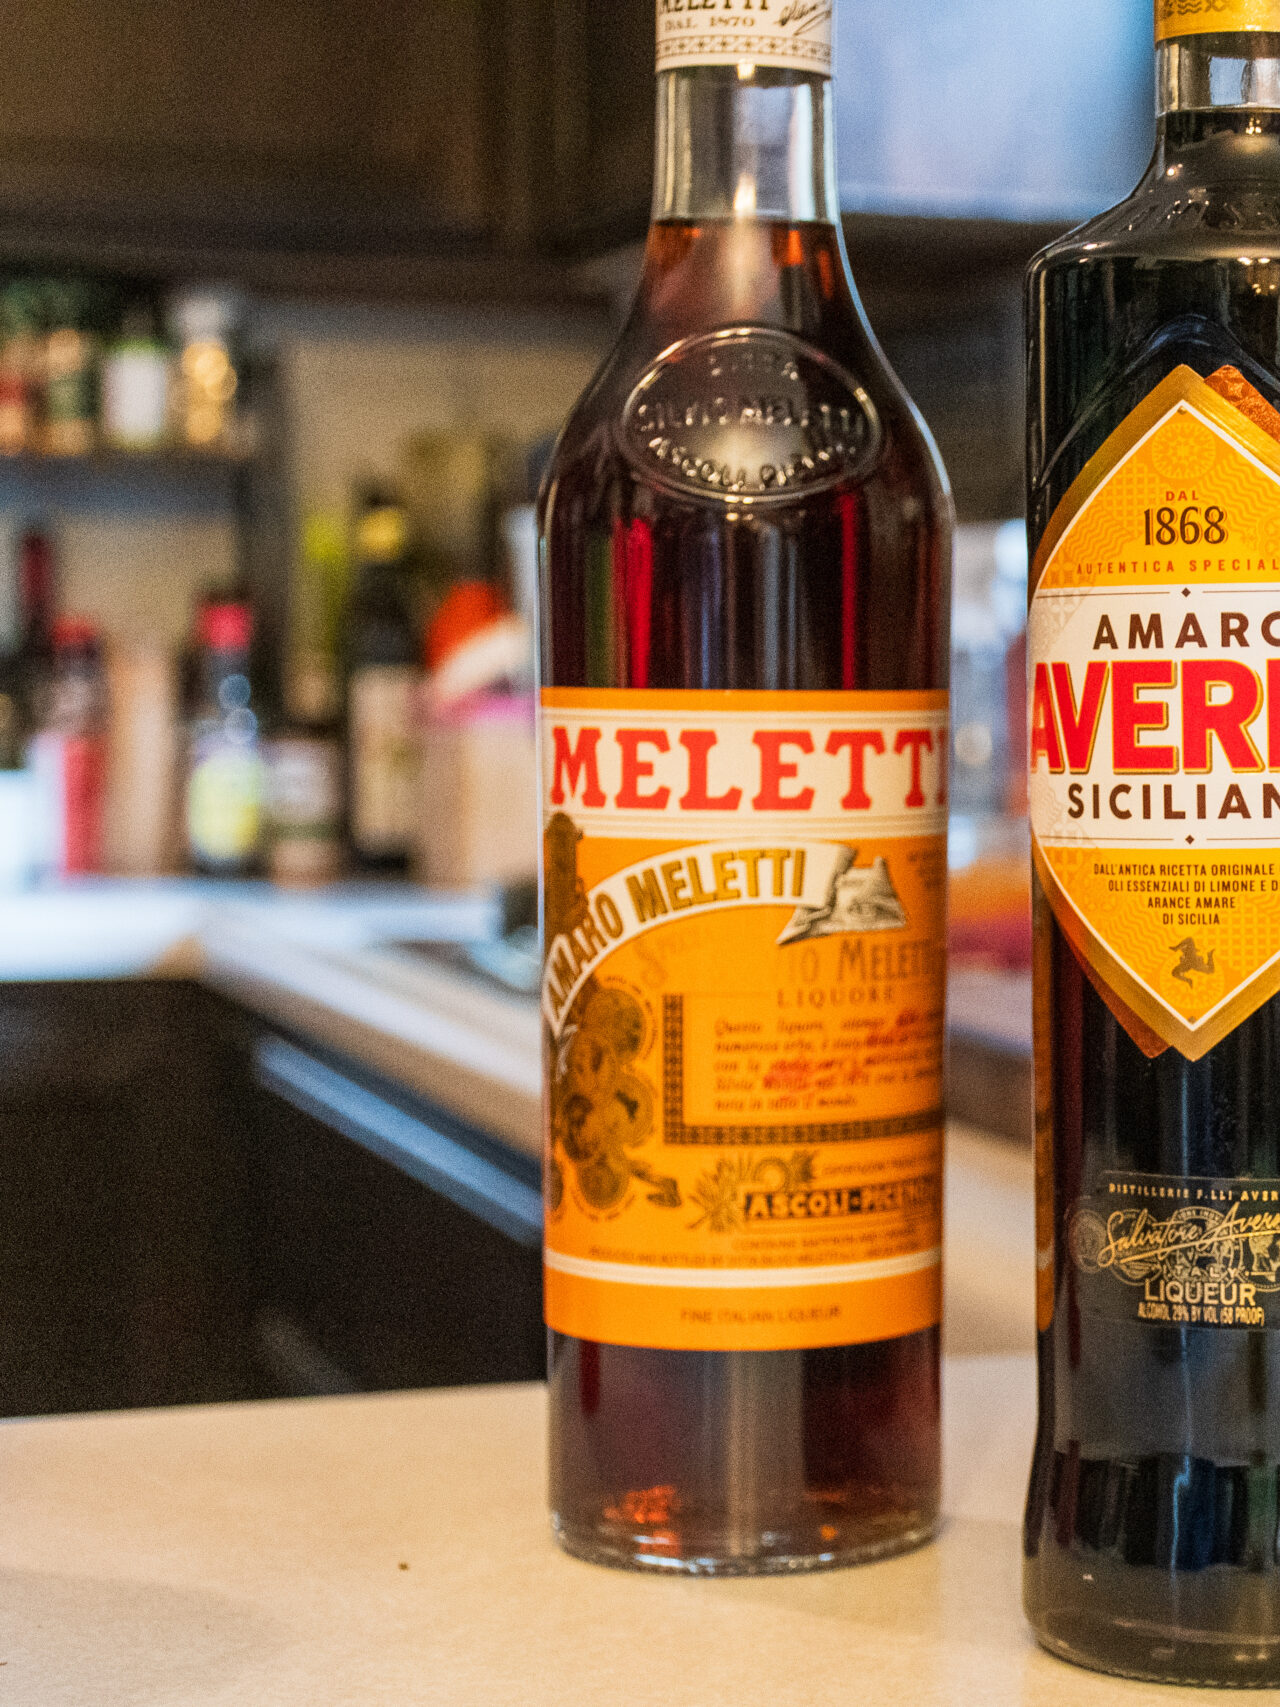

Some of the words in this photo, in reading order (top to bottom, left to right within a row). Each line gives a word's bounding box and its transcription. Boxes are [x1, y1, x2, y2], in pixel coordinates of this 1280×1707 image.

[709, 15, 755, 27] 1870
[1165, 491, 1199, 502] DAL
[1144, 505, 1229, 546] 1868
[1076, 560, 1175, 576] AUTENTICA
[1093, 863, 1156, 877] DALL'ANTICA
[1160, 863, 1207, 876] RICETTA
[1211, 863, 1275, 876] ORIGINALE
[625, 847, 806, 923] MELETTI
[1108, 879, 1124, 892] OLI
[1127, 880, 1190, 892] ESSENZIALI
[1194, 880, 1206, 892] DI
[1210, 880, 1256, 892] LIMONE
[1260, 880, 1266, 892] E
[1147, 897, 1191, 909] ARANCE
[1195, 897, 1237, 909] AMARE
[1163, 913, 1174, 925] DI
[1178, 913, 1220, 925] SICILIA
[1108, 1183, 1190, 1199] DISTILLERIE
[1196, 1188, 1233, 1200] F.LLI
[1098, 1207, 1200, 1268] Salvatore
[1144, 1279, 1257, 1306] LIQUEUR
